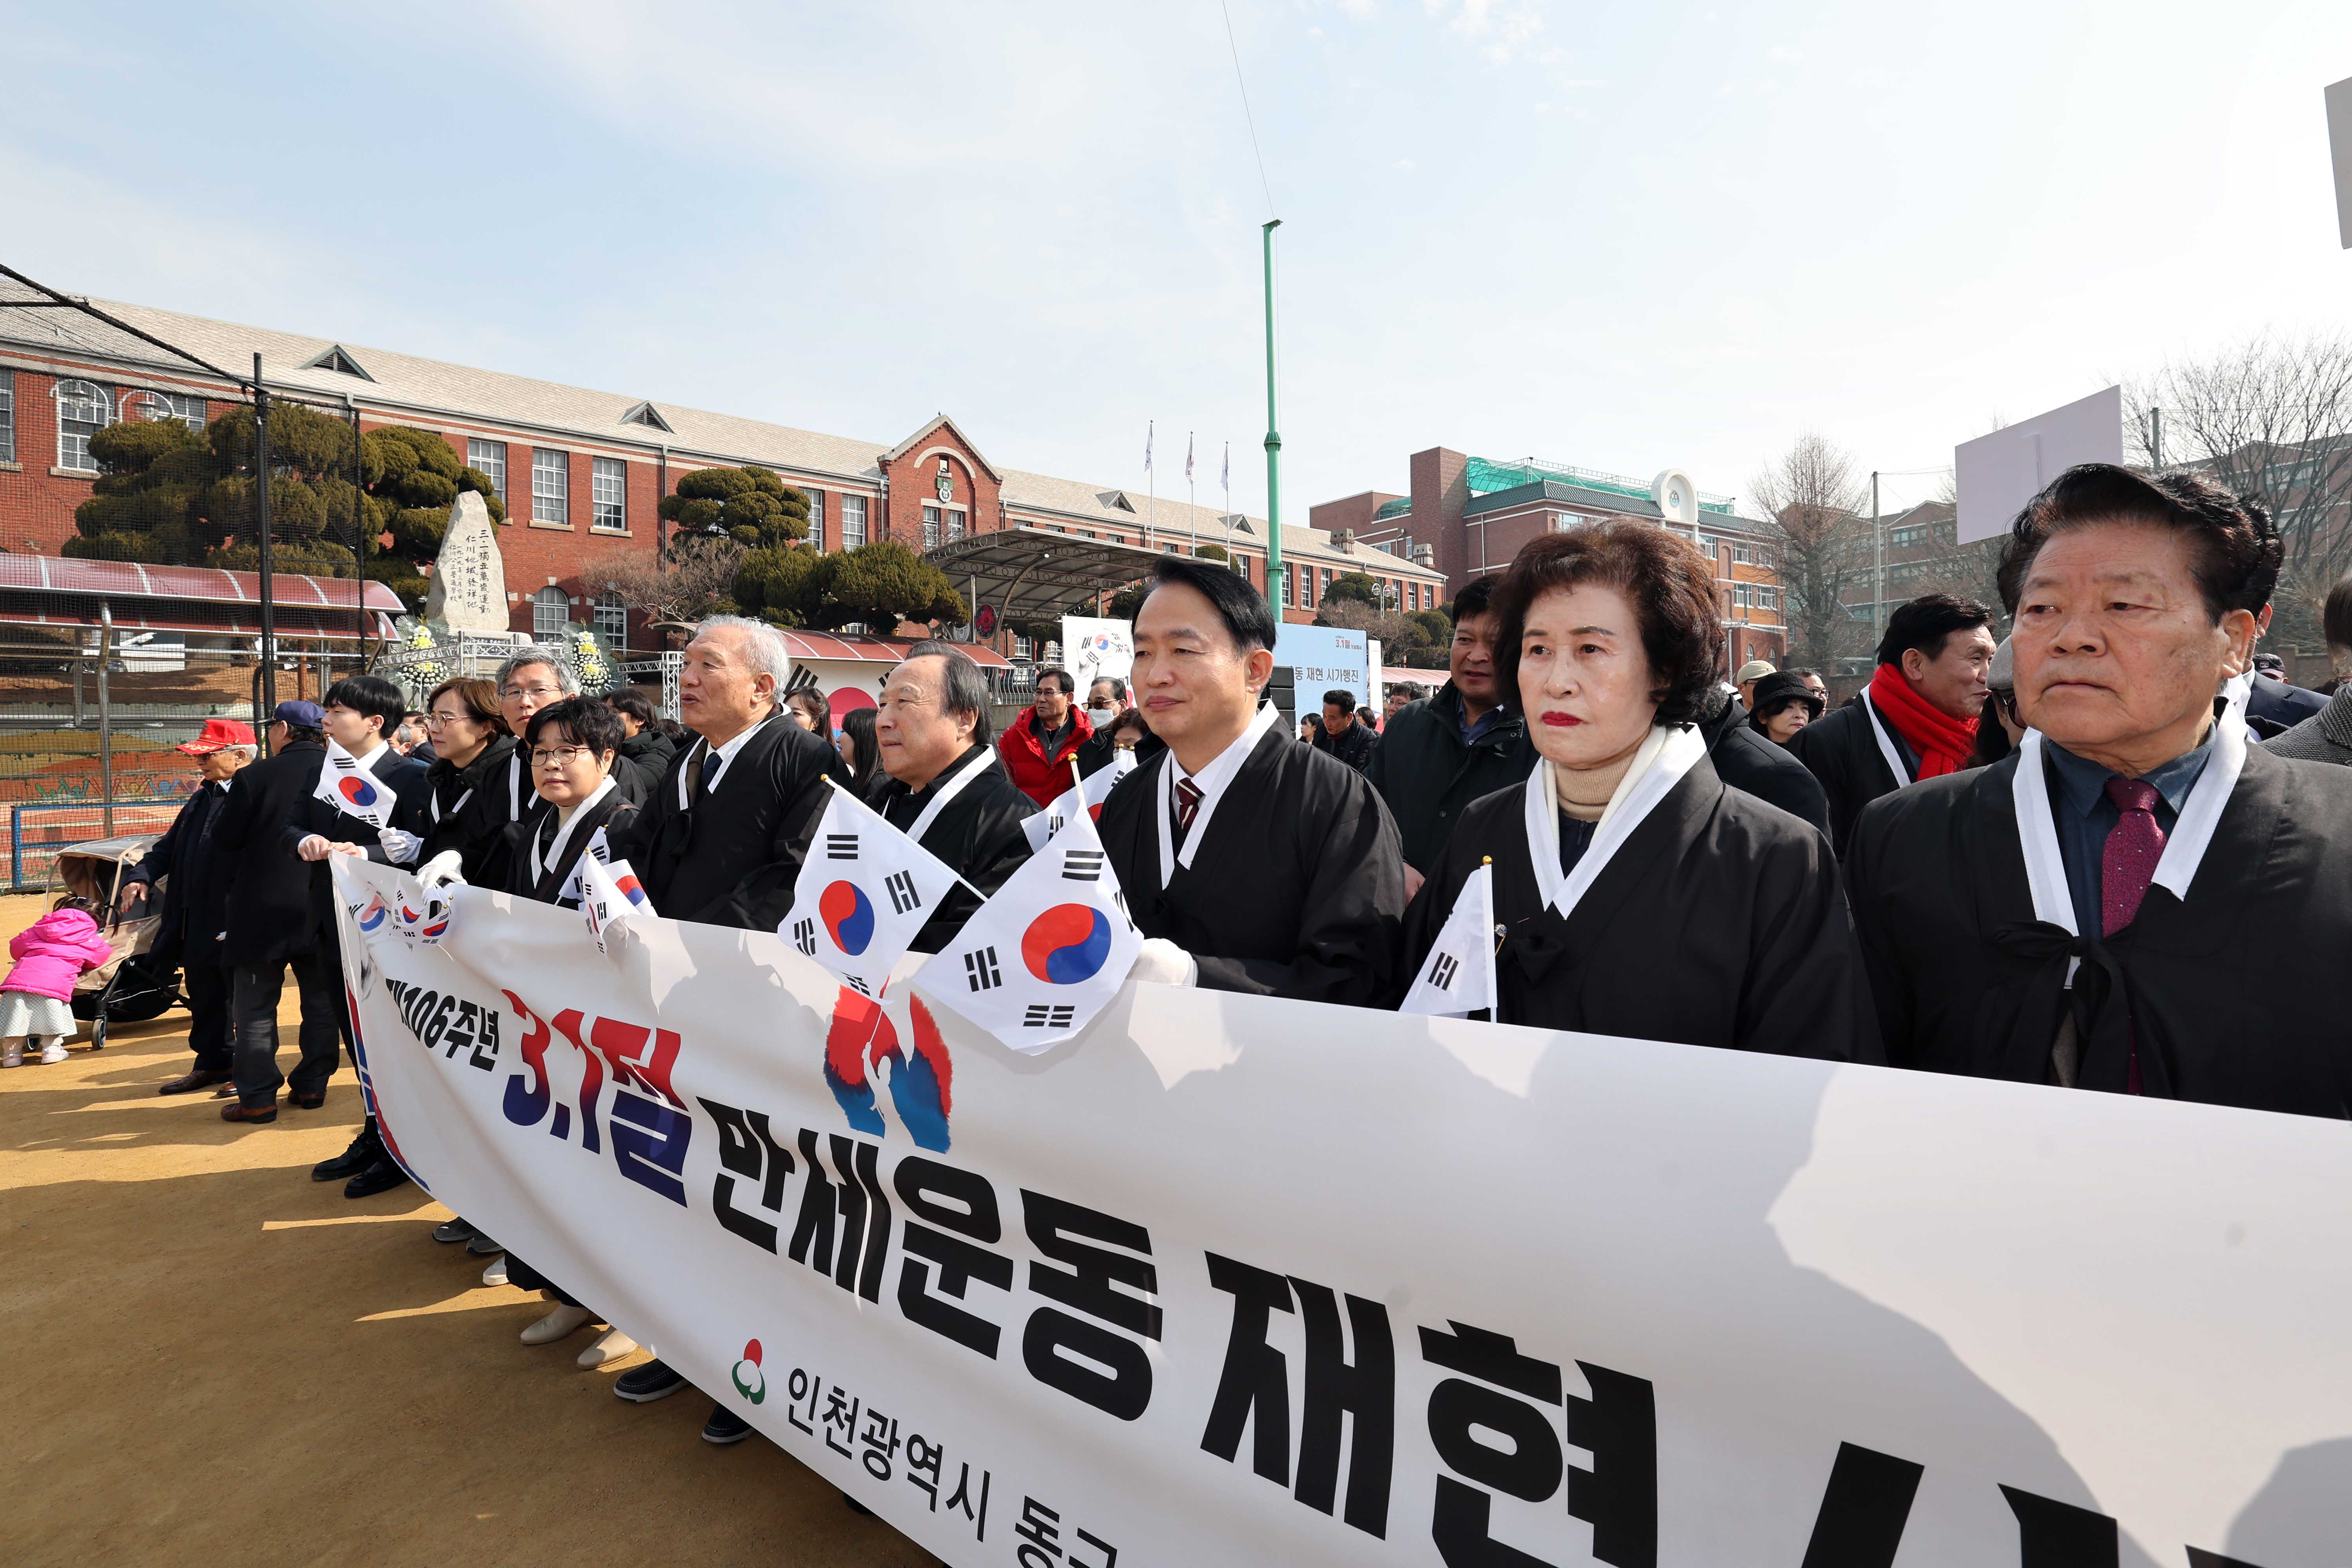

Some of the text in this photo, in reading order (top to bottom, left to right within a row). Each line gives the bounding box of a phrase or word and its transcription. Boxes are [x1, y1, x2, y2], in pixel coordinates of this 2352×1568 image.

[1307, 667, 1323, 681] 재현
[1327, 668, 1358, 682] 시가행진
[1336, 639, 1350, 649] 3.1절
[501, 989, 692, 1209] 3.1절
[695, 1096, 1163, 1421] 만세운동
[1200, 1250, 1658, 1568] 재현
[788, 1368, 991, 1543] 인천광역시
